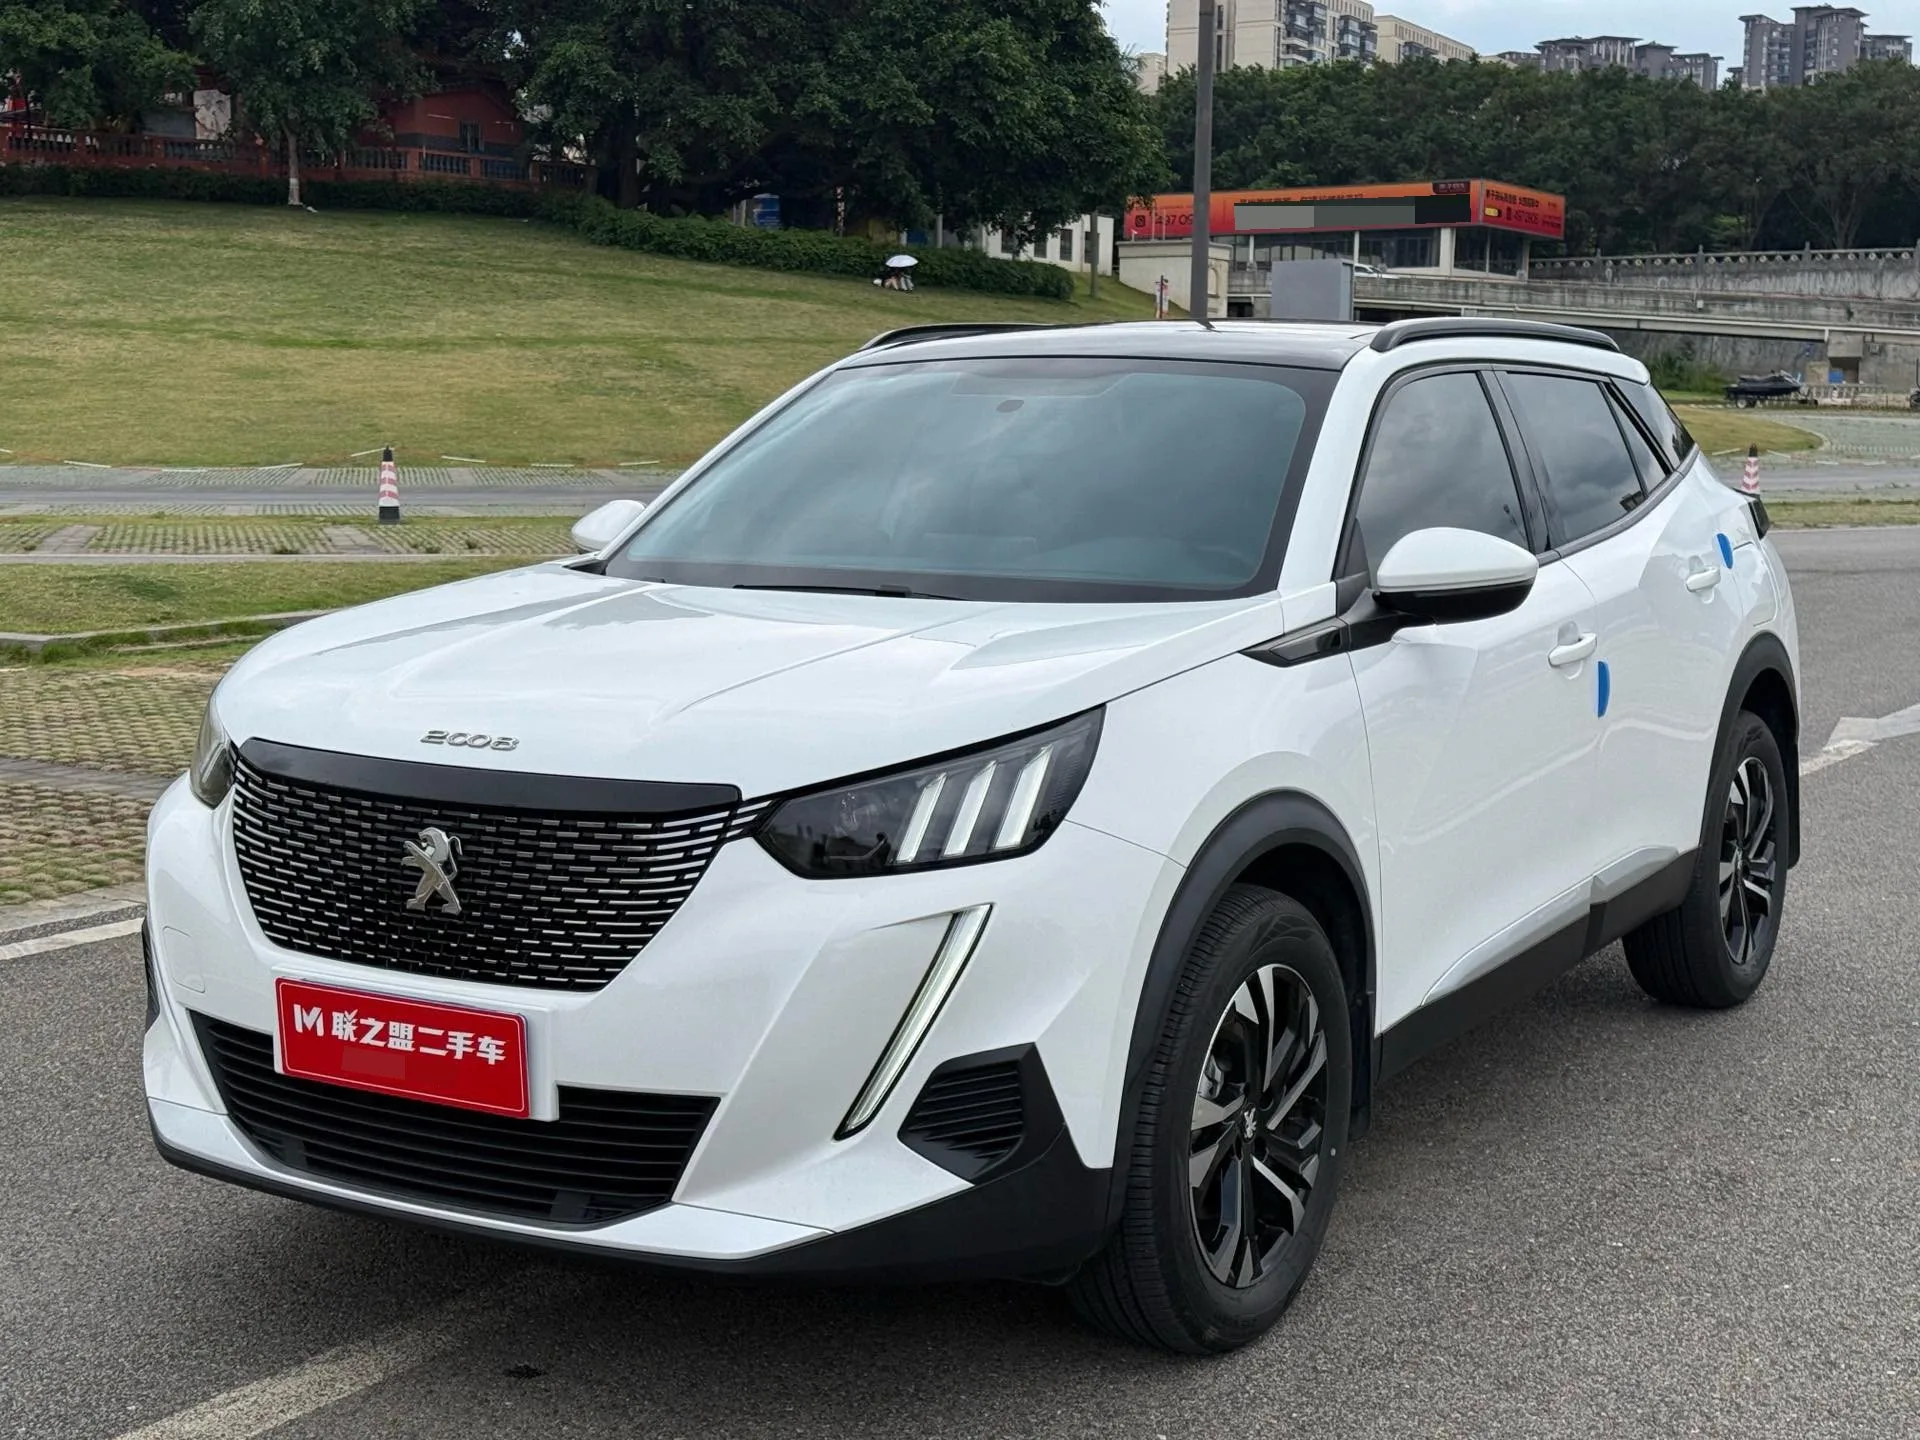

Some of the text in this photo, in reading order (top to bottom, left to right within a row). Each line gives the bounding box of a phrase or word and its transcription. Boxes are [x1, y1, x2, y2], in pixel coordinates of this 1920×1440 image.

[420, 730, 520, 751] 2008
[331, 1008, 507, 1065] 联之盟二手车
